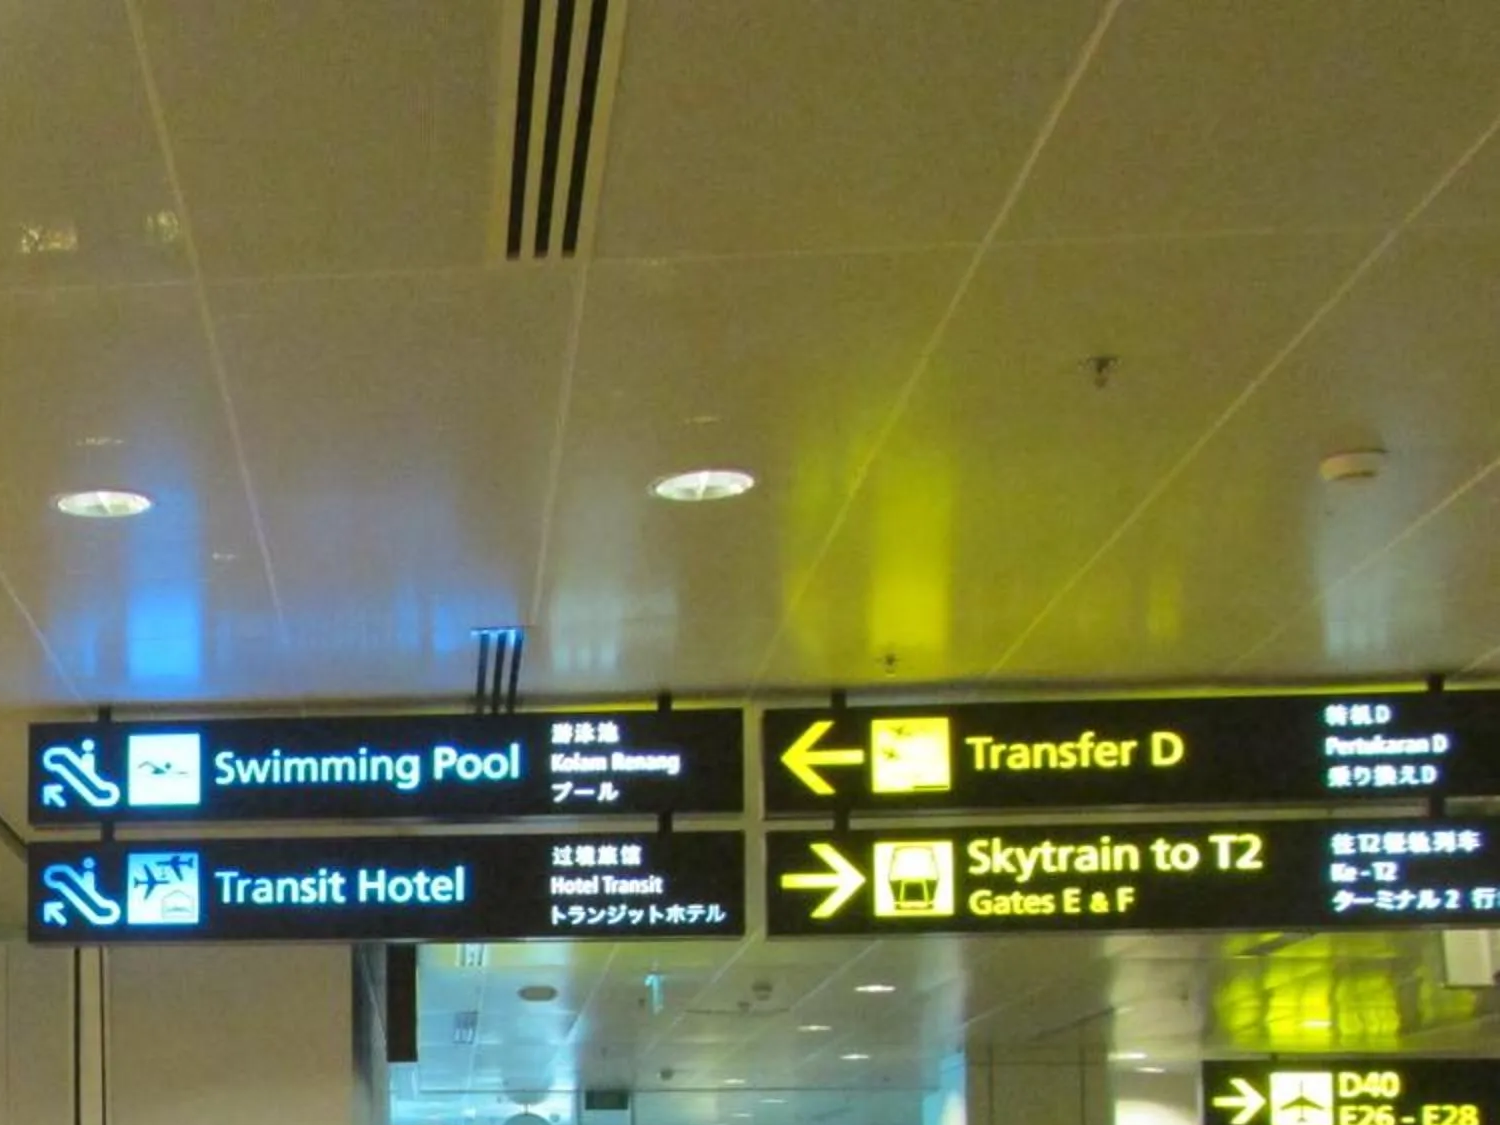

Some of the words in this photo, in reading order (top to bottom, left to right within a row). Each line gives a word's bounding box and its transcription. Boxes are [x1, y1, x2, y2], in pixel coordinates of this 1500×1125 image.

[966, 731, 1137, 770] Transfer
[1151, 731, 1184, 767] D
[1432, 733, 1449, 753] D
[215, 748, 419, 789] Swimming
[433, 742, 521, 780] Pool
[967, 836, 1140, 881] Skytrain
[1151, 838, 1200, 872] to
[1208, 834, 1263, 870] T2
[214, 868, 349, 904] Transit
[357, 866, 466, 903] Hotel
[551, 876, 598, 894] Hotel
[601, 875, 663, 894] Transit
[552, 903, 726, 925] トランジットホテル
[969, 889, 1055, 916] Gates
[1063, 889, 1082, 913] E
[1089, 889, 1110, 914] &
[1117, 888, 1135, 912] F
[1338, 1072, 1400, 1098] D40
